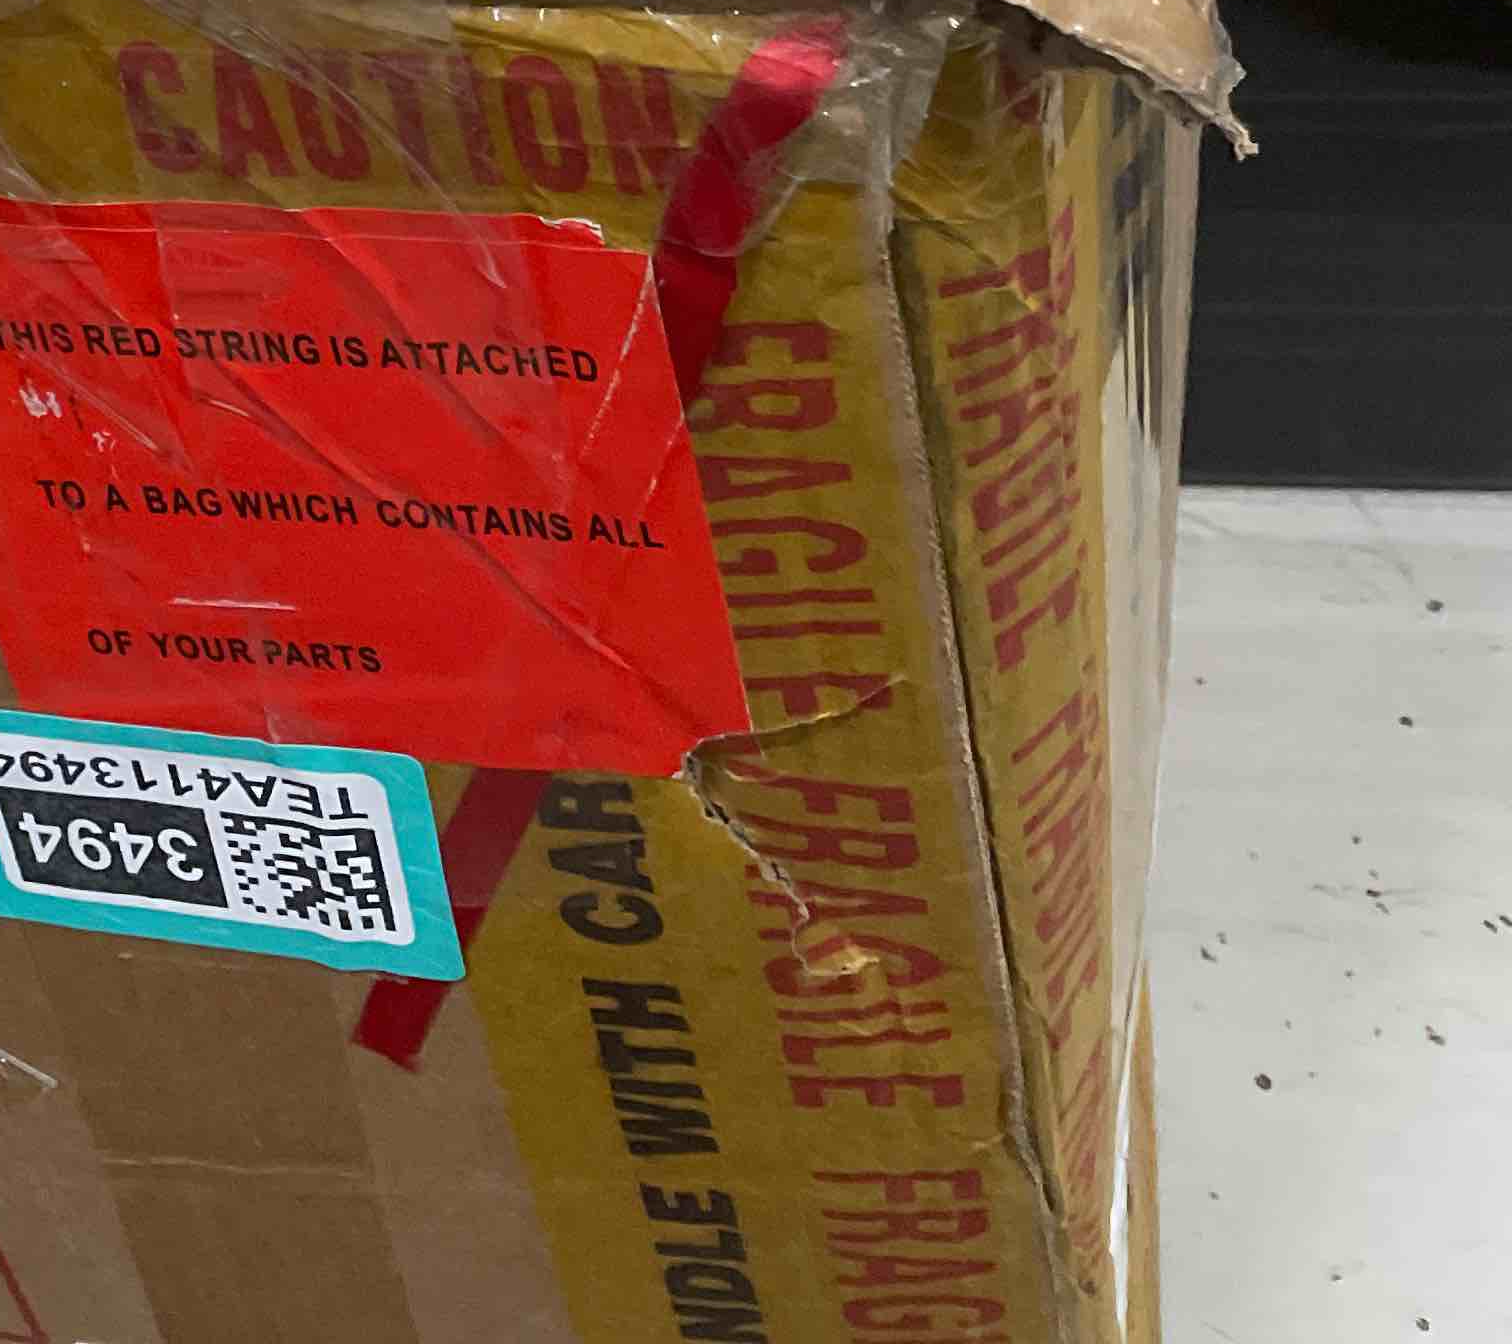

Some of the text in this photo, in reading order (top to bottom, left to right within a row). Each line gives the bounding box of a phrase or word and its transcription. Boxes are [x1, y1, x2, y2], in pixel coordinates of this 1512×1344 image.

[116, 41, 691, 197] CAUTION
[84, 323, 163, 359] RED
[176, 327, 321, 367] STRING
[330, 335, 371, 370] IS
[380, 338, 600, 383] ATTACHED
[37, 479, 664, 549] TO A BAG WHICH CONTAINS ALL
[691, 320, 896, 757] FRAGILE
[88, 628, 384, 674] OF YOUR PARTS
[19, 812, 204, 881] 3494
[723, 759, 966, 1110] FRAGILE
[538, 775, 769, 1344] NDLE WITH CAR
